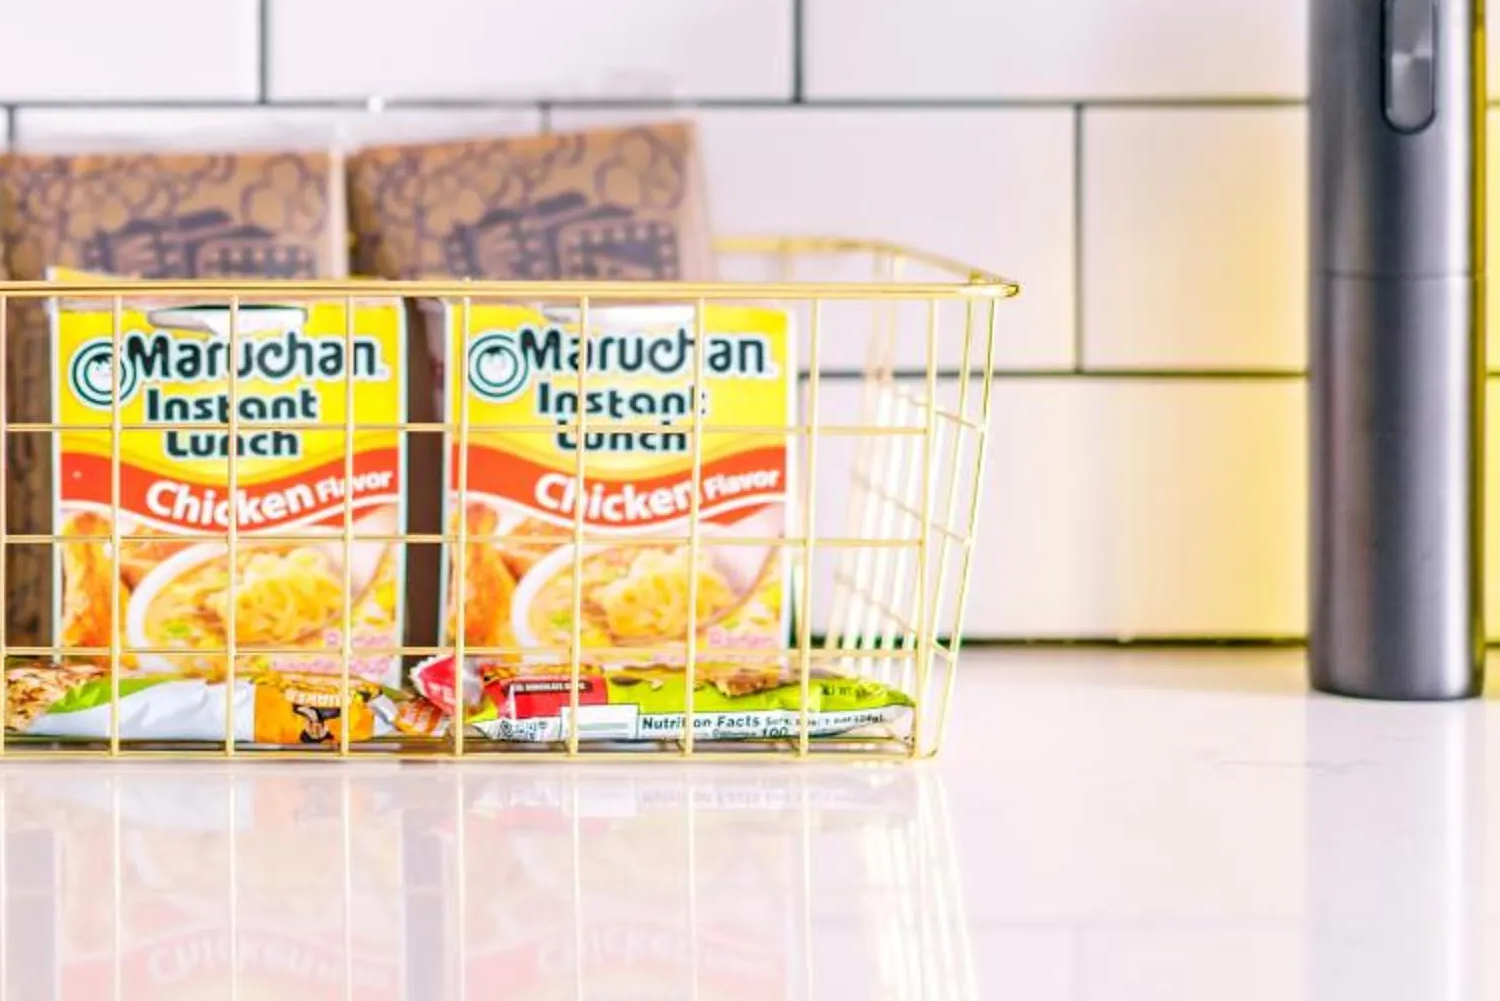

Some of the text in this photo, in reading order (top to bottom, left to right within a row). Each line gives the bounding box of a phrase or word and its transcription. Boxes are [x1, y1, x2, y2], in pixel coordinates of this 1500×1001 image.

[128, 330, 376, 378] Maruchan
[521, 328, 764, 374] Maruchan
[147, 387, 318, 424] Instant
[167, 429, 298, 456] Lunch
[557, 419, 686, 451] Lunch
[146, 480, 316, 526] Chicken
[534, 470, 780, 521] Chicken Flavor
[642, 716, 712, 730] Nutrion
[717, 714, 760, 728] Facts
